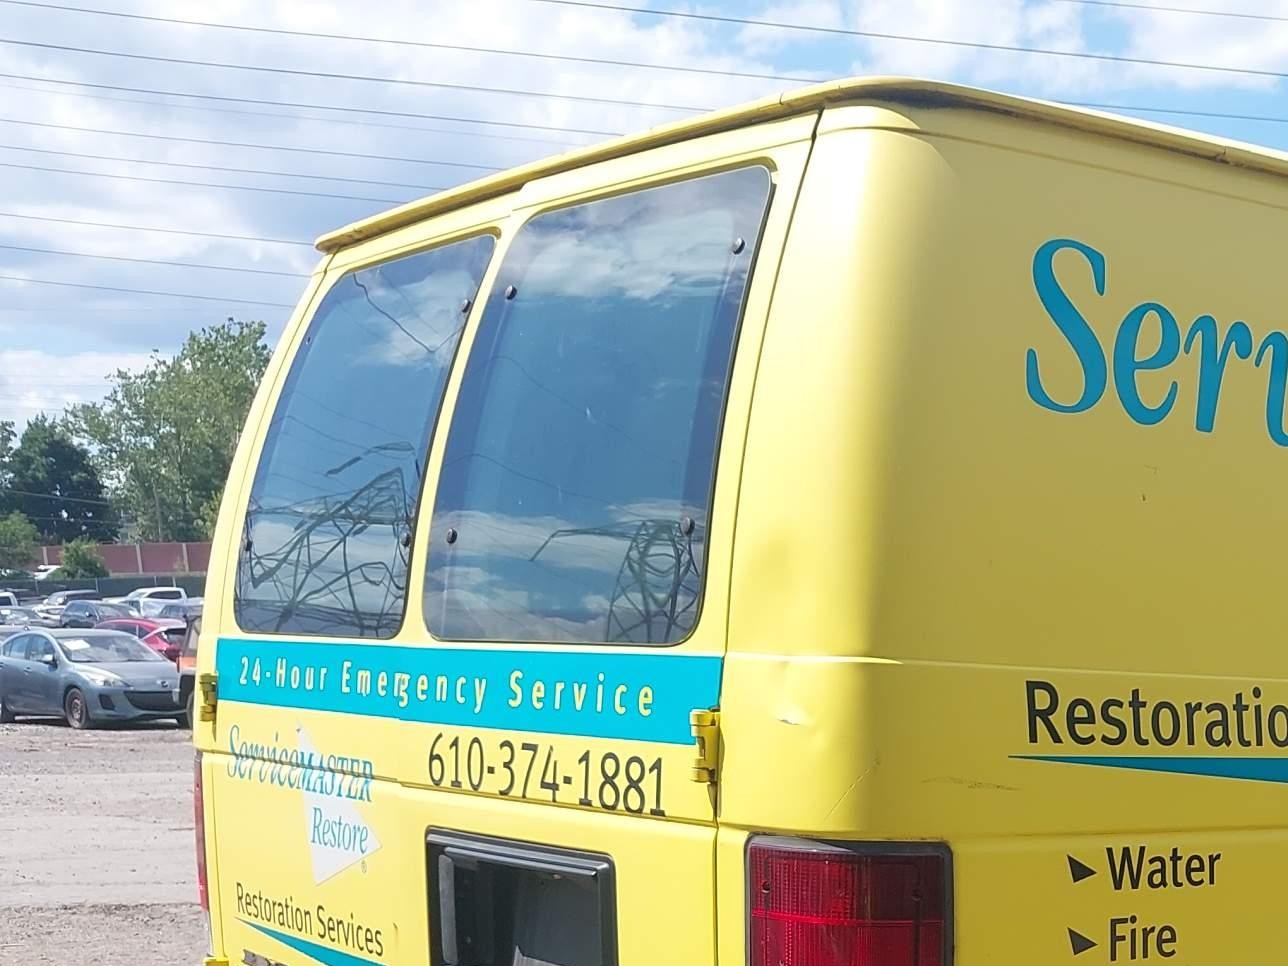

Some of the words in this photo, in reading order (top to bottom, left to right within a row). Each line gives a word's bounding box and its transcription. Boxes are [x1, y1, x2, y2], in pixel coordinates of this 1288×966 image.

[239, 655, 328, 692] 24-Hour
[341, 660, 487, 713] Emergency
[508, 670, 654, 717] Service
[428, 732, 666, 817] 610-374-1881
[311, 807, 369, 854] Restore
[1105, 845, 1222, 891] Water
[236, 882, 313, 935] Restoration
[316, 905, 384, 957] Services
[1109, 915, 1178, 962] Fire
